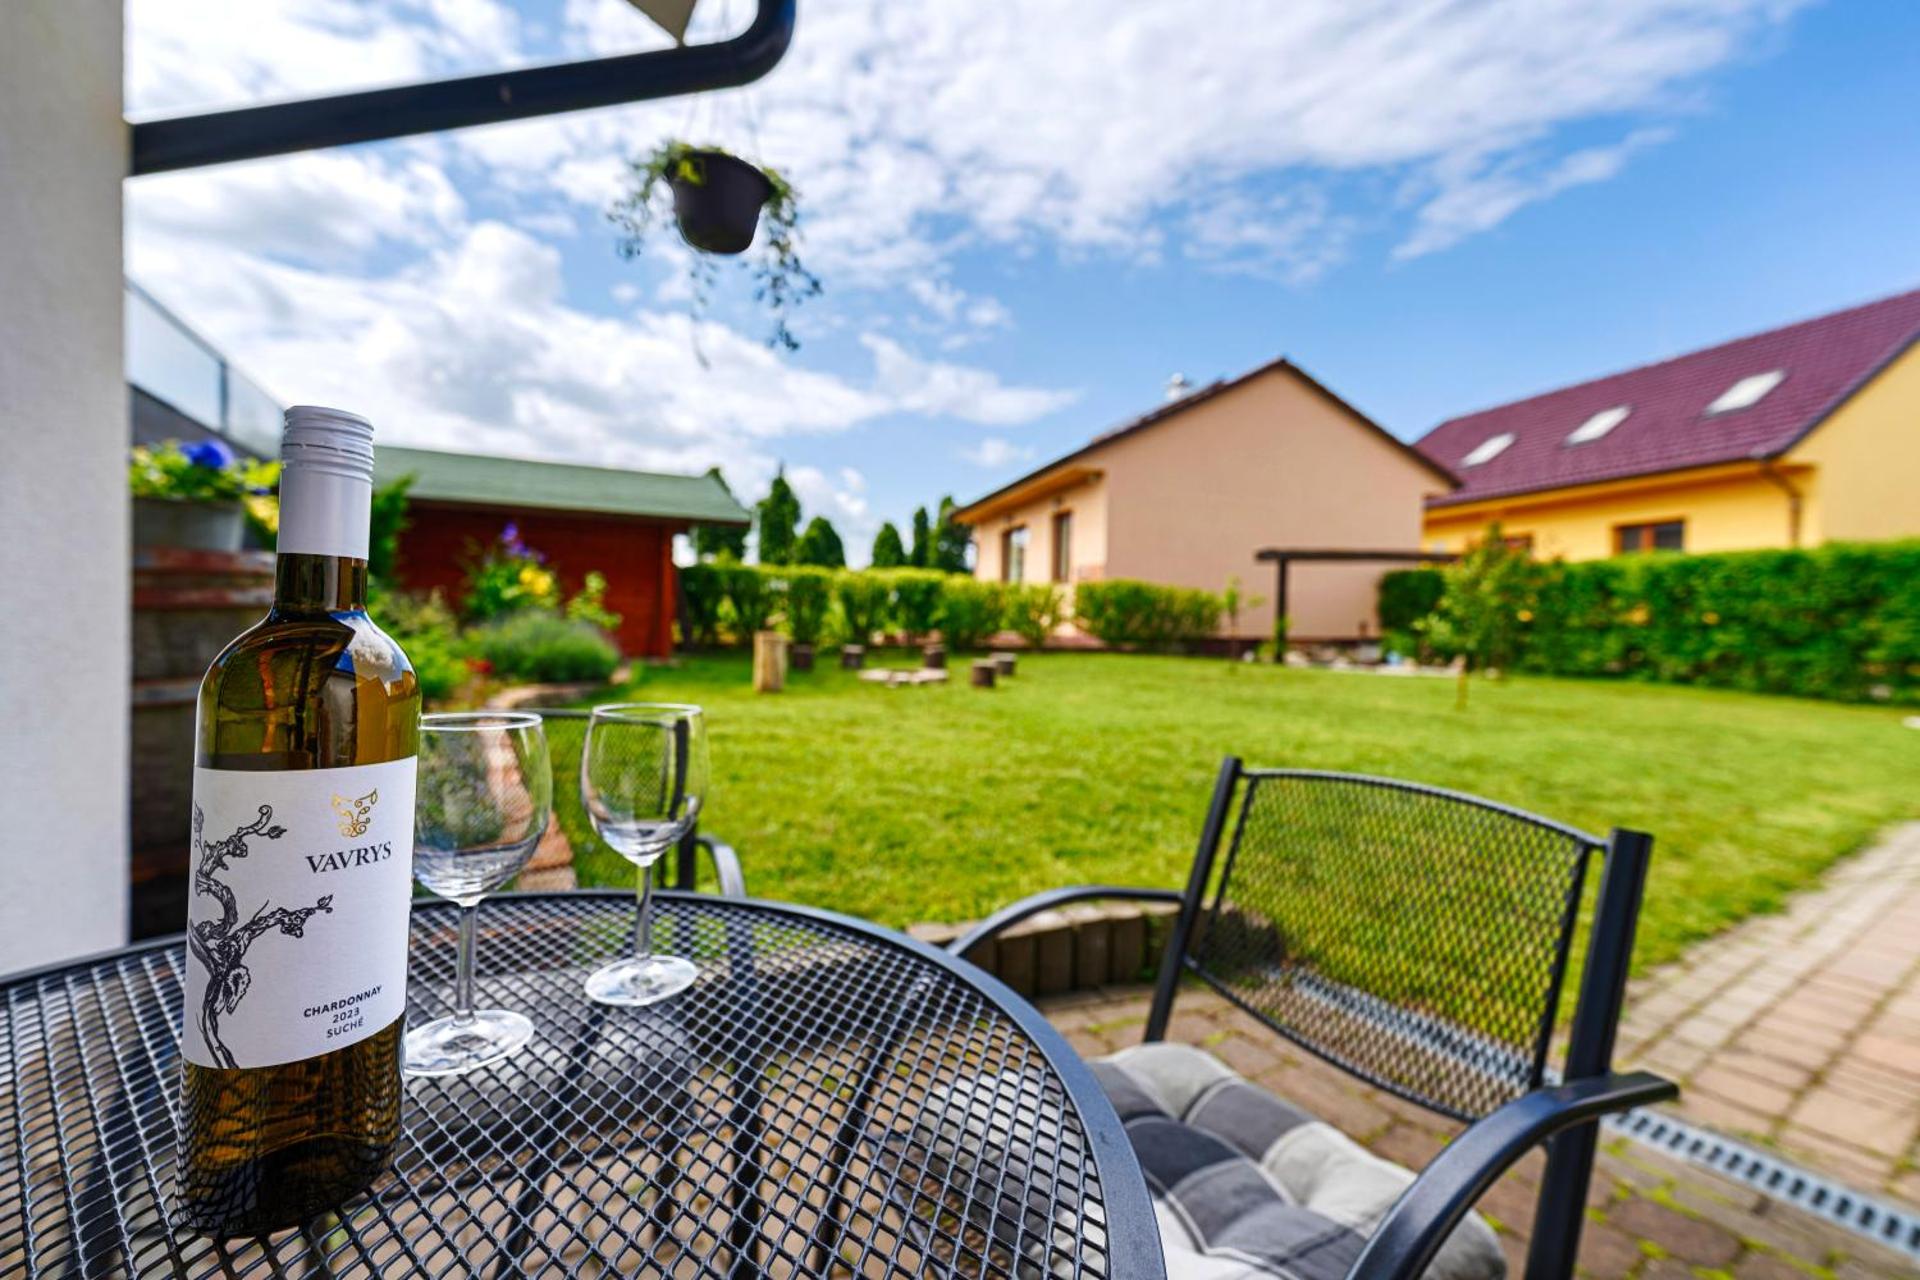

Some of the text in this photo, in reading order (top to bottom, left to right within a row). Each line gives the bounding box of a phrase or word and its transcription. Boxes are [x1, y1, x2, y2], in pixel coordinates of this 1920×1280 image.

[305, 841, 392, 874] VAVRYS
[303, 984, 382, 1018] CHARDONNAY
[326, 1016, 364, 1039] SUCHÉ
[332, 1007, 360, 1024] 2023
